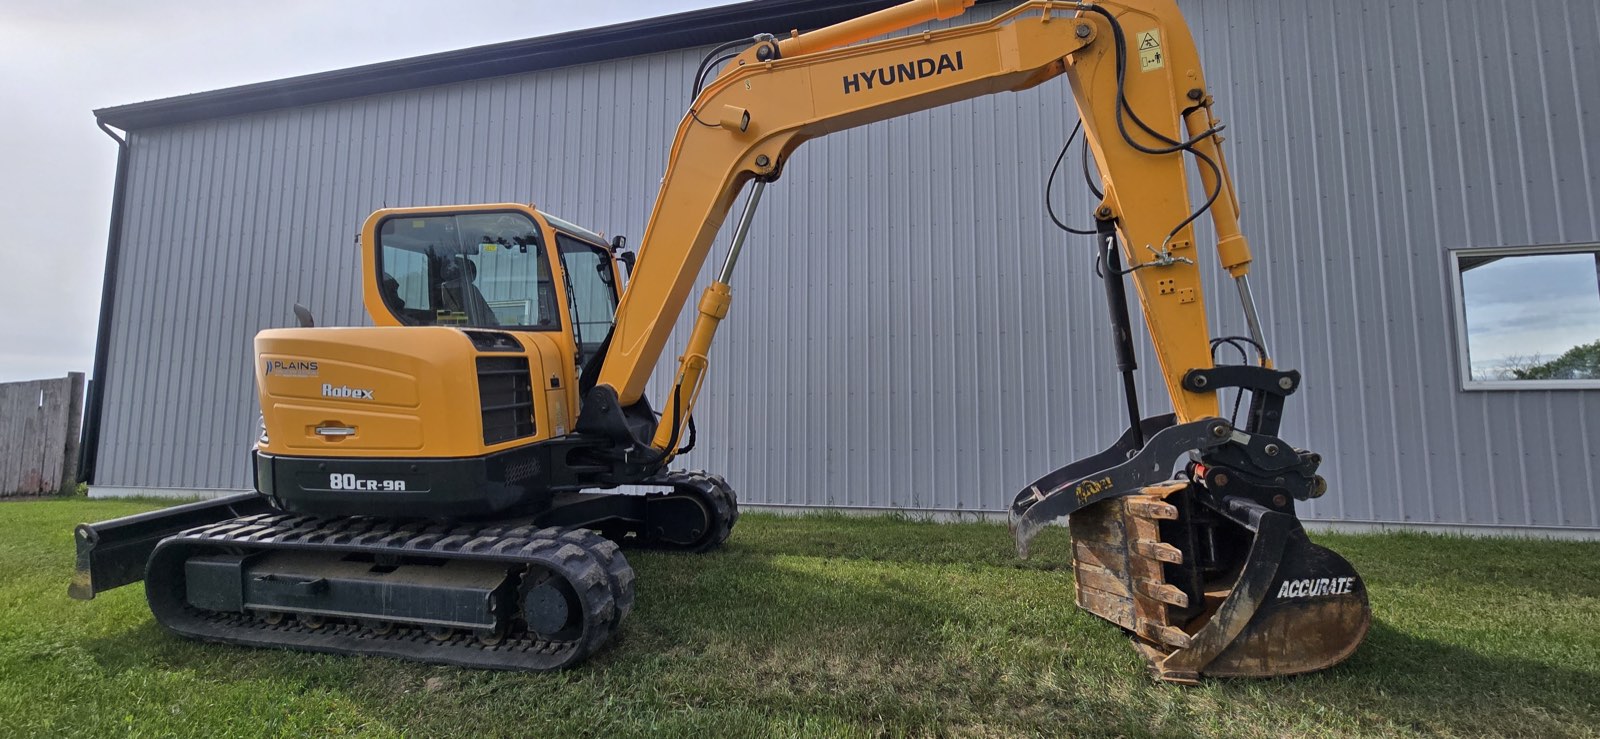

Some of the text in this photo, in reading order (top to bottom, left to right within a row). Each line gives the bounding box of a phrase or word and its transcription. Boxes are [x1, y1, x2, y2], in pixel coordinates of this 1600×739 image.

[843, 51, 963, 94] HYUNDAI
[275, 361, 318, 370] PLAINS
[330, 473, 405, 490] 80CR-9A
[1277, 577, 1355, 598] ACCURATE
